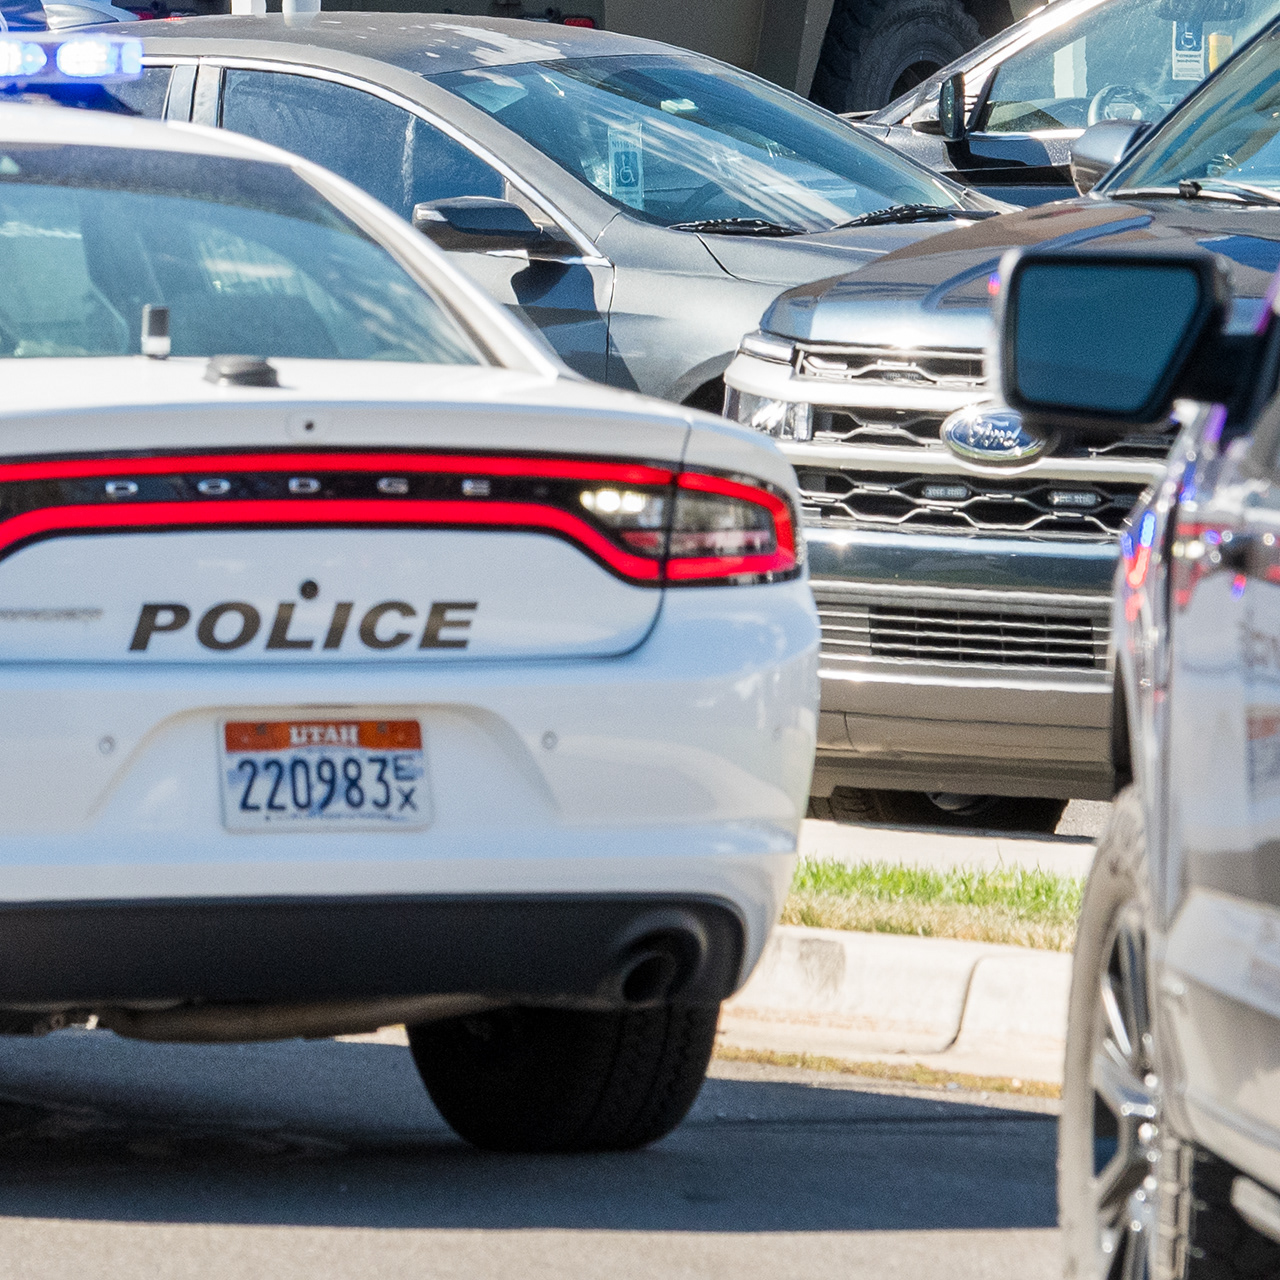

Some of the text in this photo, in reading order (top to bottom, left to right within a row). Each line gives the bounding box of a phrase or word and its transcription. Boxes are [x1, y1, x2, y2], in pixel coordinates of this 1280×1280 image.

[105, 477, 491, 497] DODGE
[129, 600, 478, 652] POLICE
[290, 725, 358, 743] UTAH
[238, 757, 391, 811] 220983
